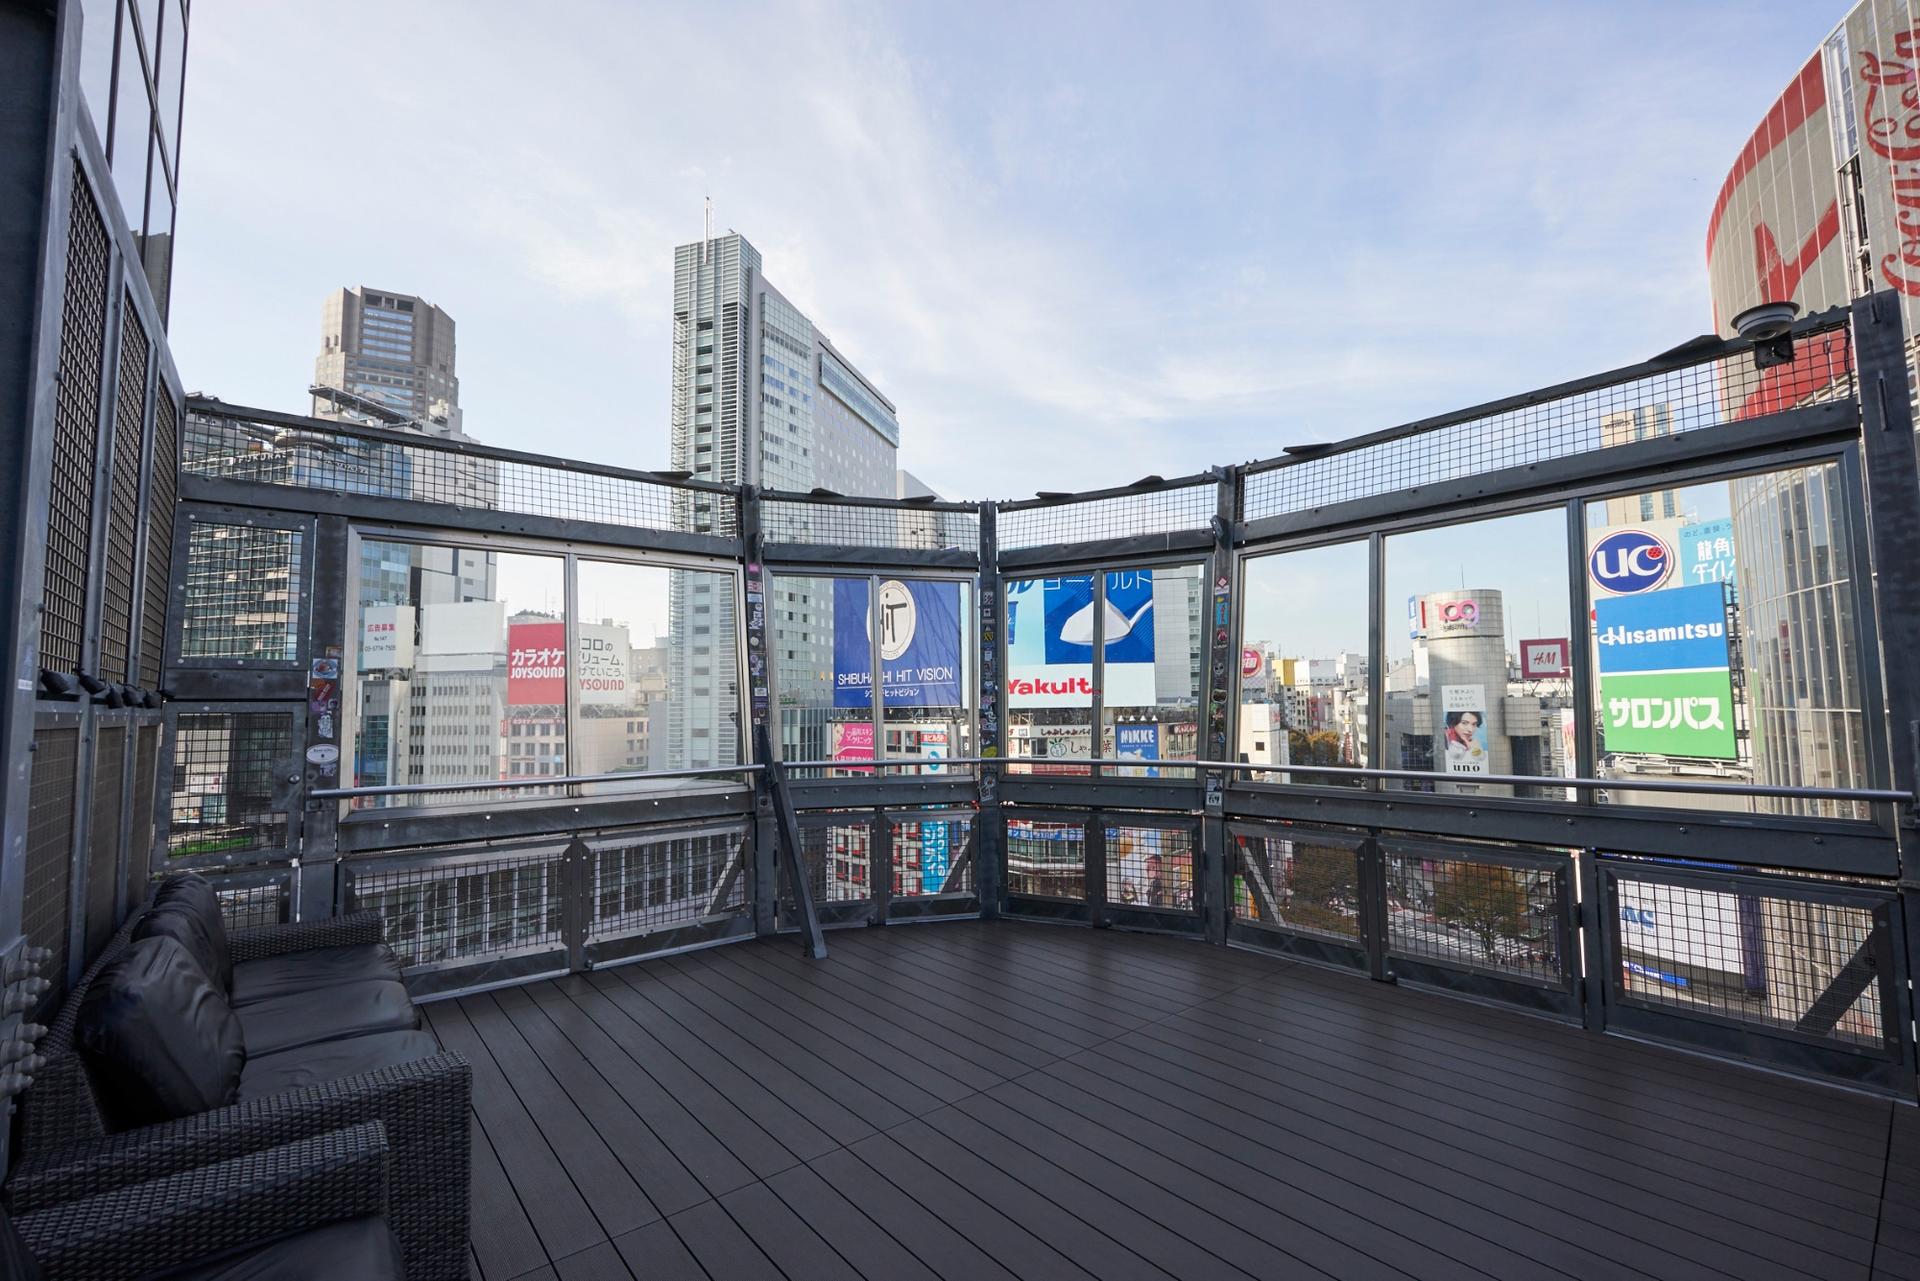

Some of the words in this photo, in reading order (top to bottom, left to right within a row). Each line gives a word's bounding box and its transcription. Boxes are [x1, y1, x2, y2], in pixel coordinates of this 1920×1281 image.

[1696, 537, 1735, 562] 龍角
[1044, 571, 1152, 590] ヨールト
[1435, 600, 1480, 628] 109
[1599, 622, 1723, 646] Hisamitsu
[579, 638, 613, 651] コロの
[511, 648, 564, 666] カラオケ
[1533, 652, 1556, 665] H&M
[510, 667, 565, 679] JOYSOUND
[838, 671, 892, 685] SHIBUHHI
[896, 669, 912, 682] HIT
[916, 666, 953, 681] VISION
[864, 688, 920, 698] シヒットビジョン
[1008, 677, 1092, 696] Yakult
[1608, 696, 1724, 731] サロンパス
[1041, 727, 1111, 737] しゃぶしゃぶバイグ
[1120, 729, 1155, 744] NIKKE
[1070, 739, 1113, 754] しゃ葉
[1453, 764, 1480, 772] uno
